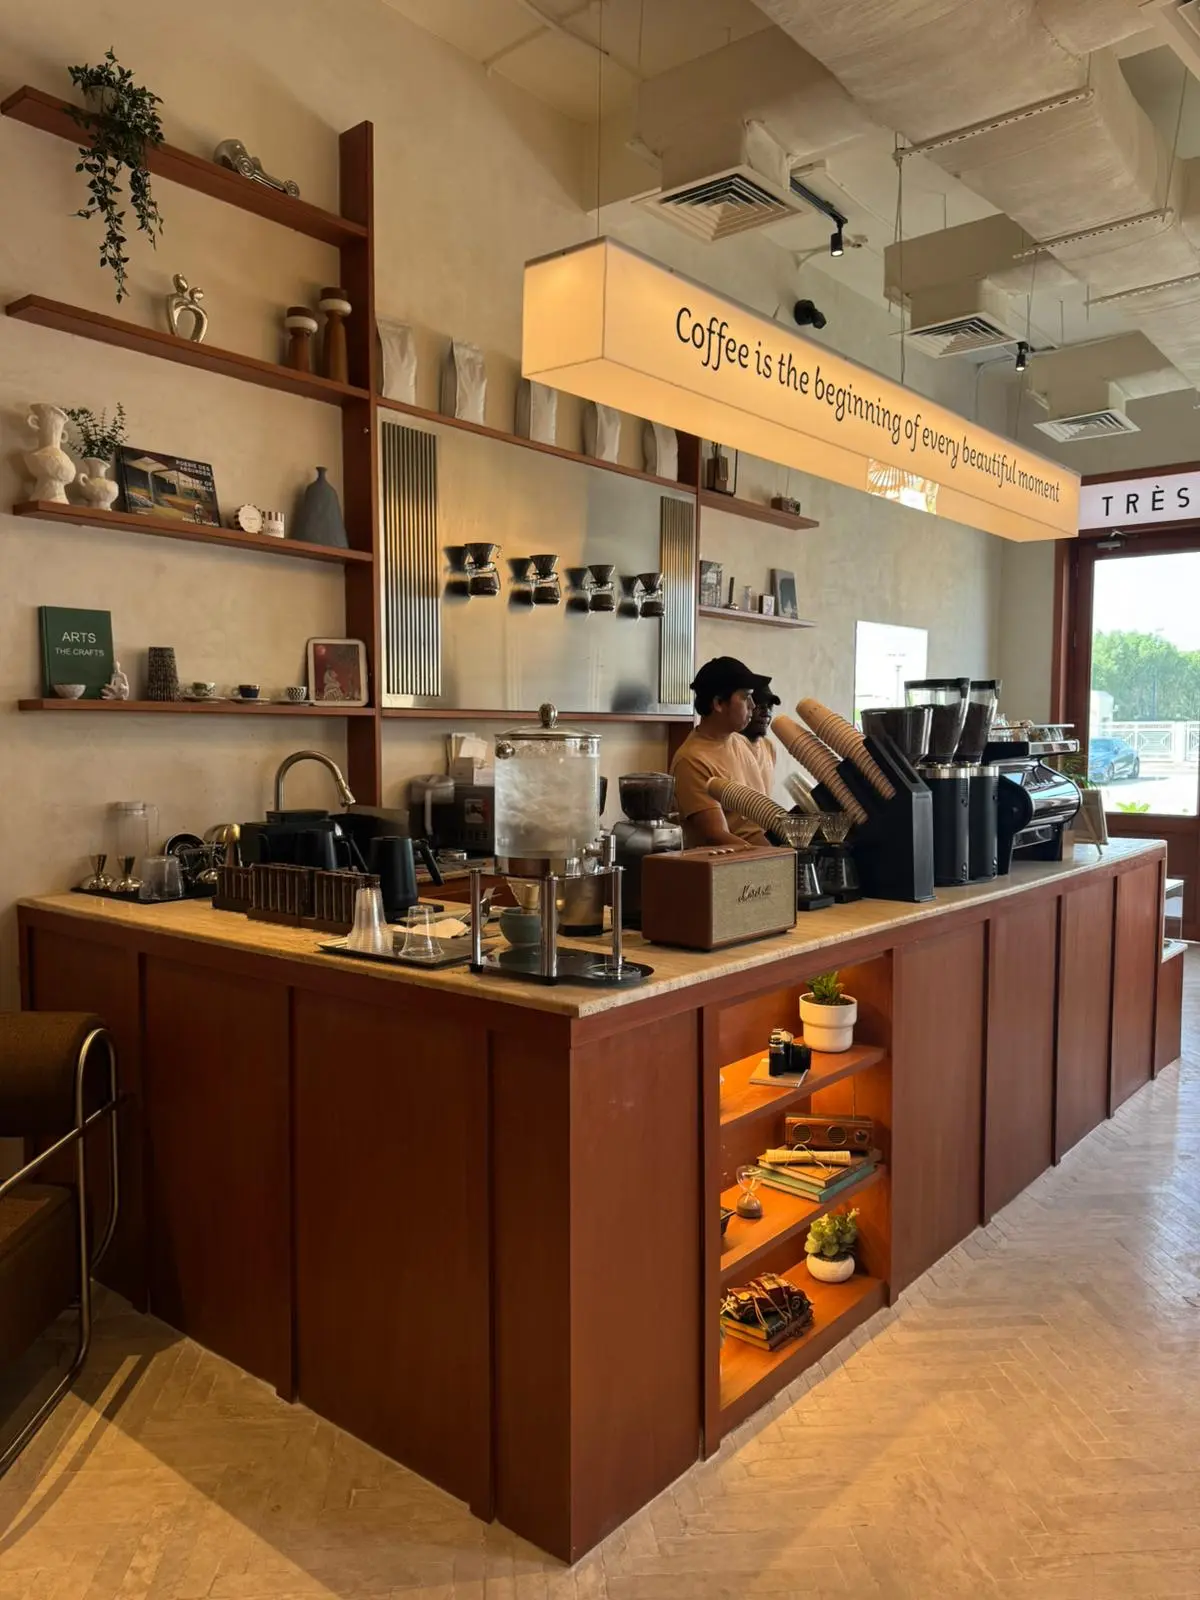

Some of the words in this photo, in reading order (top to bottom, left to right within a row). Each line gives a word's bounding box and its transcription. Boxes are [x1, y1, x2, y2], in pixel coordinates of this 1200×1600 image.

[675, 306, 750, 372] Coffee
[754, 340, 773, 379] is
[777, 352, 810, 395] the
[814, 365, 902, 446] beginning
[904, 413, 922, 452] of
[922, 426, 960, 469] every
[962, 435, 1017, 488] beautiful
[1017, 468, 1060, 503] moment
[1101, 484, 1190, 517] TRÈS
[62, 631, 97, 644] ARTS
[55, 646, 71, 656] THE
[72, 647, 105, 657] CRAFTS
